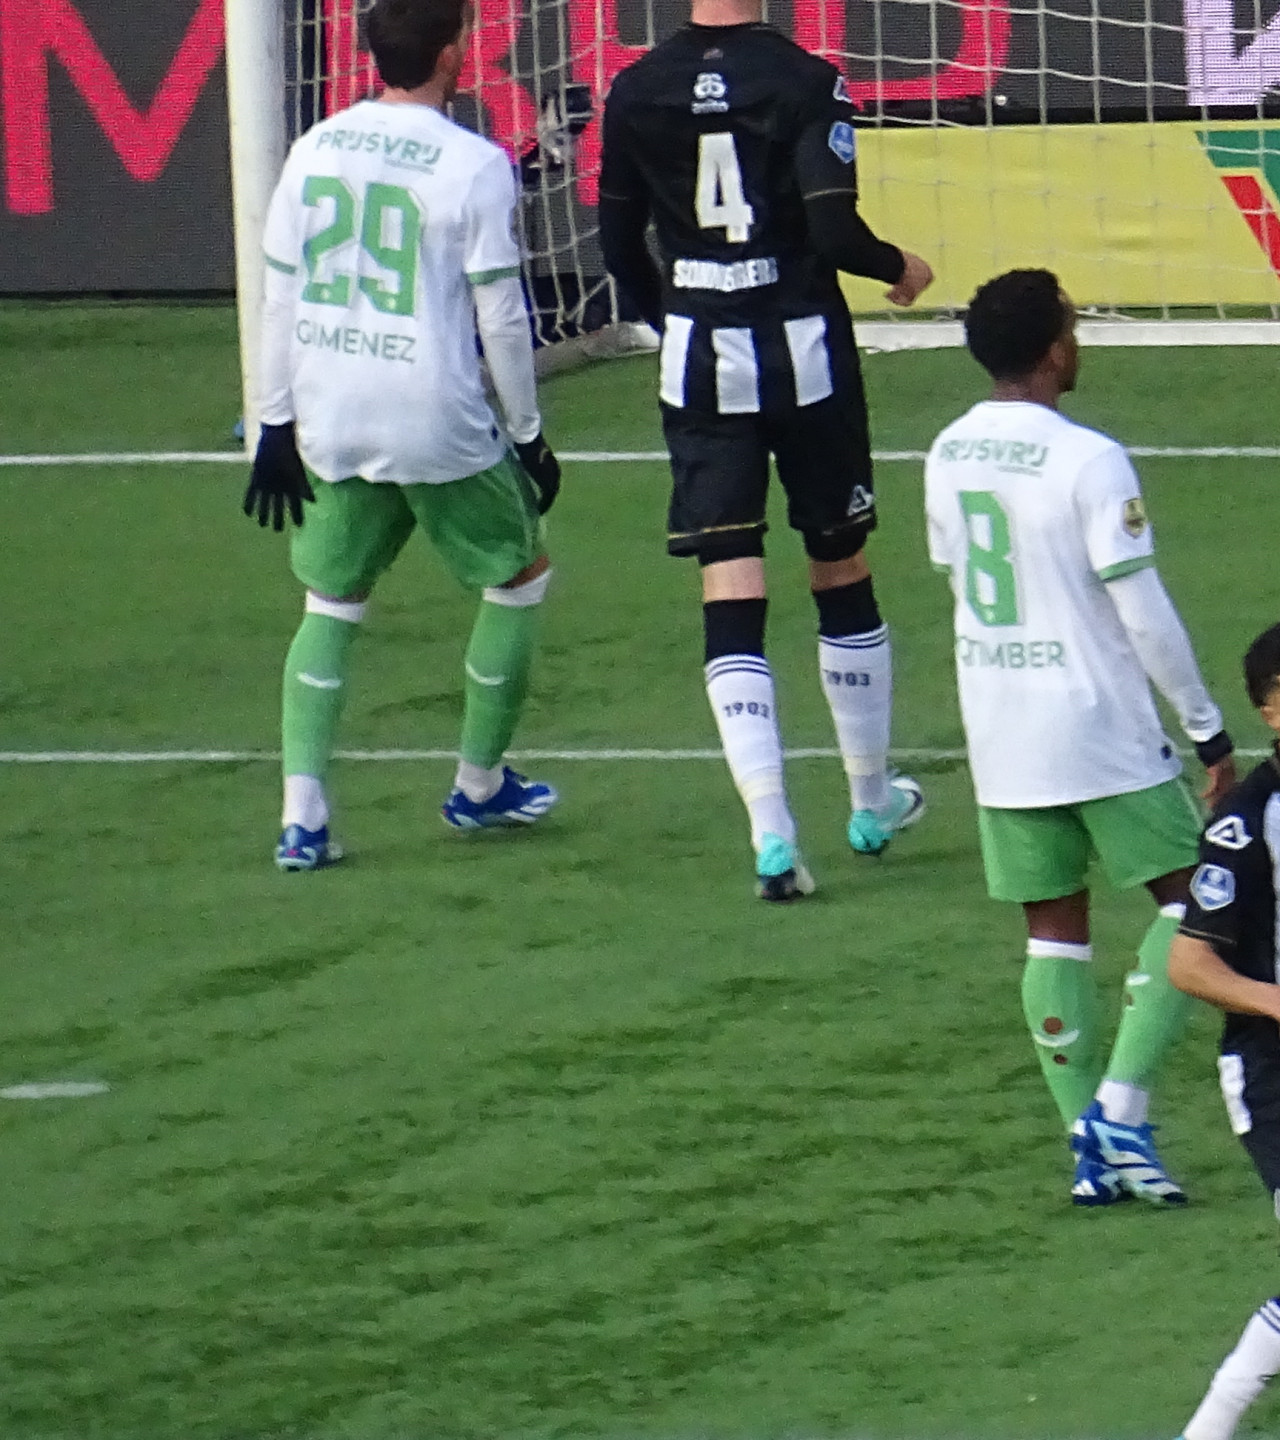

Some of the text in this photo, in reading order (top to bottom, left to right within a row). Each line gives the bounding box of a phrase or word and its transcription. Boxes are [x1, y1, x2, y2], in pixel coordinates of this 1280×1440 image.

[301, 175, 425, 318] 29
[694, 131, 754, 244] 4
[296, 319, 417, 364] GIMENEZ
[957, 489, 1022, 627] 8
